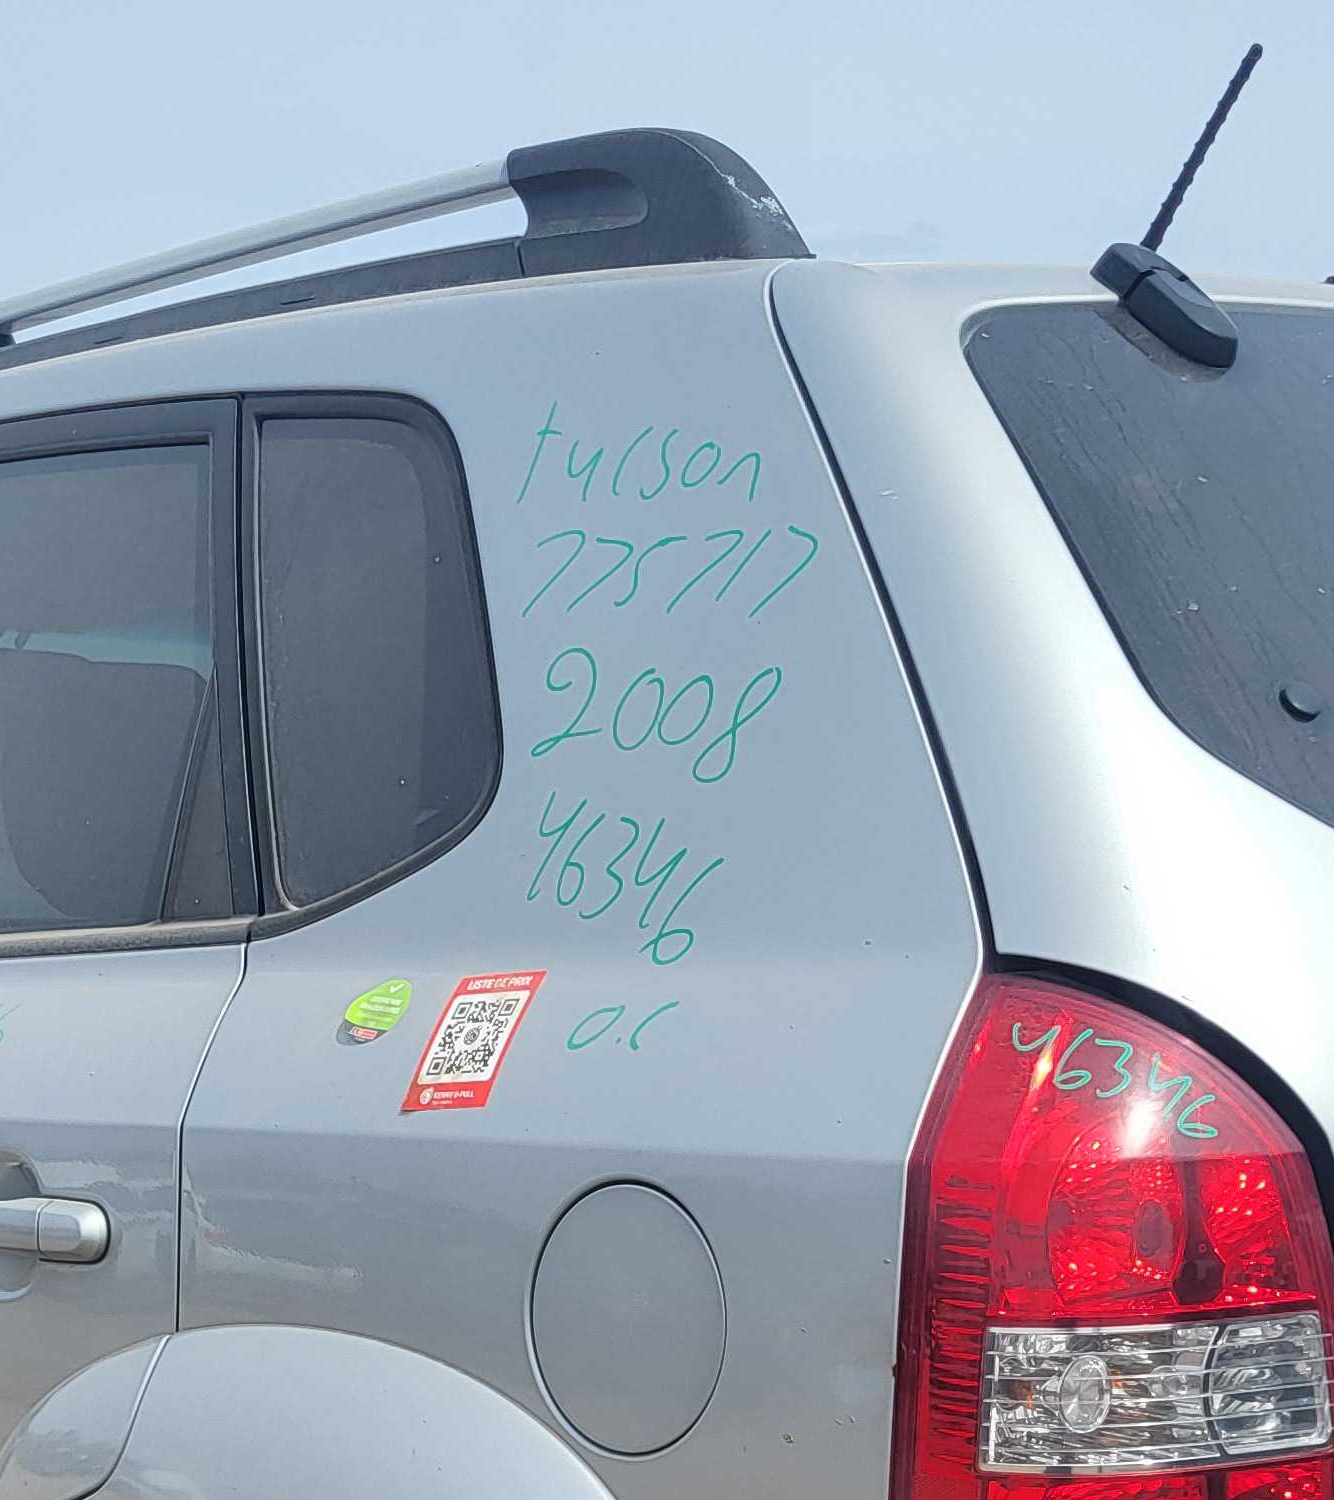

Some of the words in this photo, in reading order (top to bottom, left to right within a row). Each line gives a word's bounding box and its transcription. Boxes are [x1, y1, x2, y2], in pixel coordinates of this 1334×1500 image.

[521, 524, 819, 618] 775717
[530, 646, 782, 783] 2008
[526, 790, 725, 965] 46346
[1012, 1022, 1219, 1139] 46346
